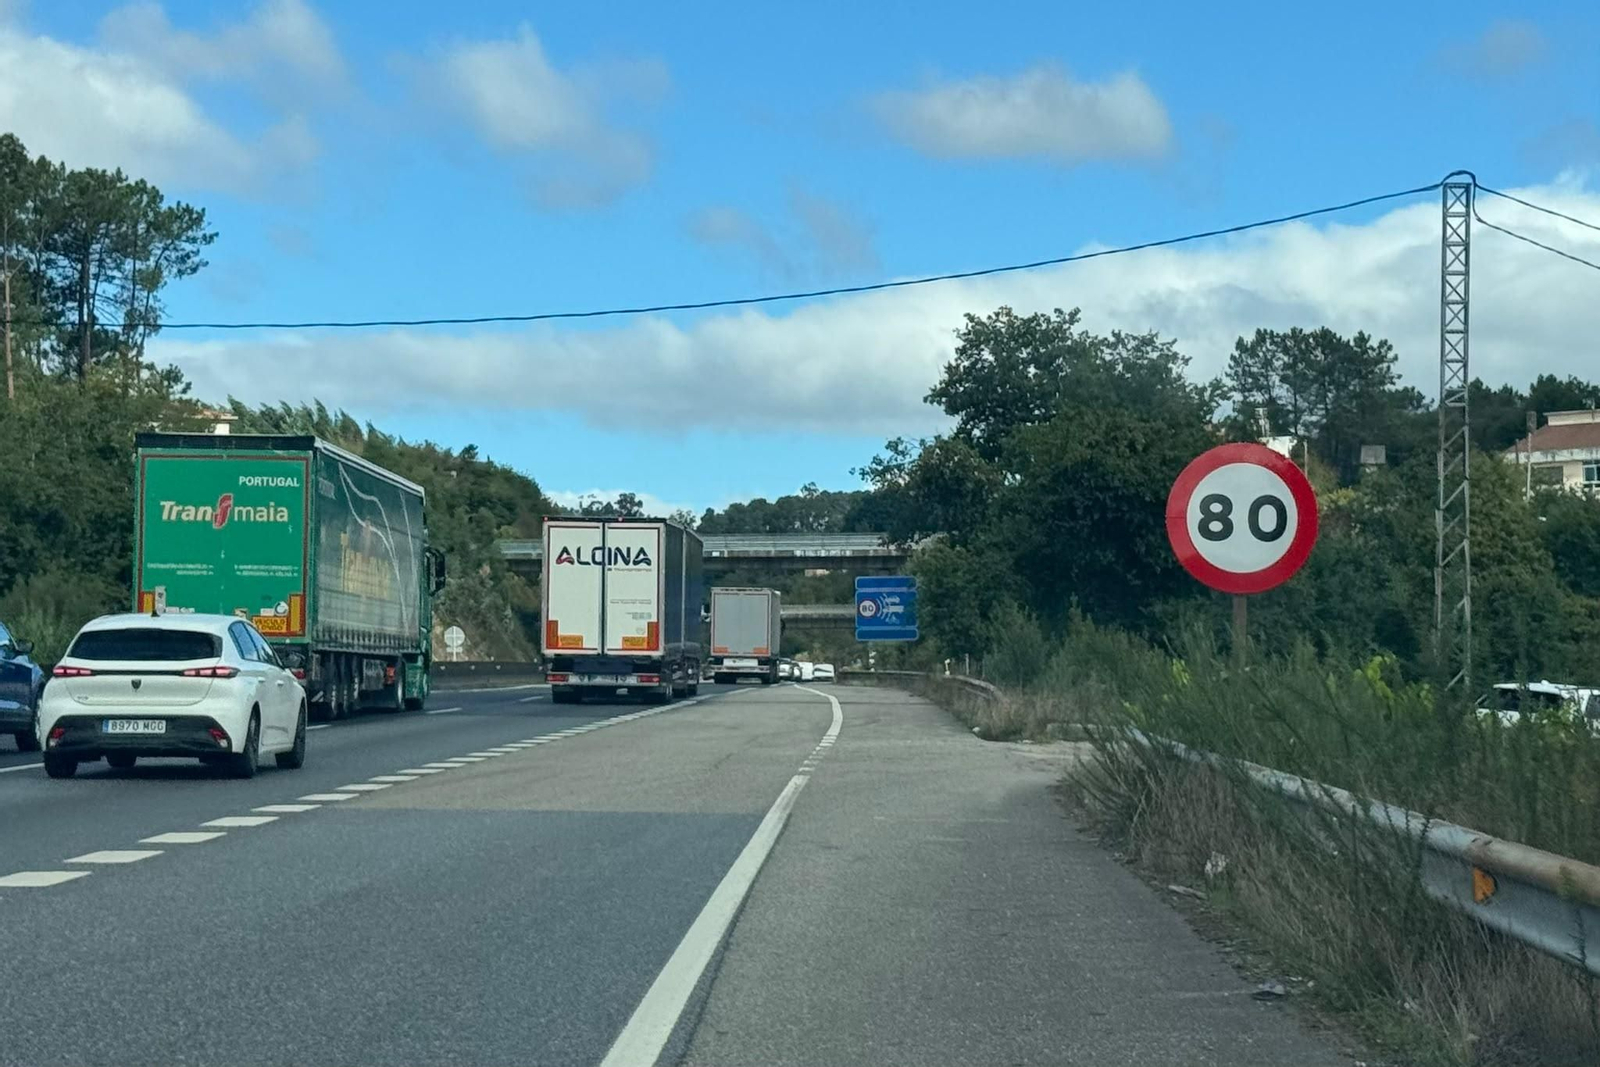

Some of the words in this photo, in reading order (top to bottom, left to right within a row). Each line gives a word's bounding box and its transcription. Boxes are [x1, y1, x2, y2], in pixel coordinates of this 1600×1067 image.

[239, 476, 300, 487] PORTUGAL
[1197, 493, 1288, 543] 80
[555, 546, 652, 566] ALCINA
[861, 604, 874, 613] 80
[111, 721, 139, 731] 8970
[143, 721, 164, 731] MGG
